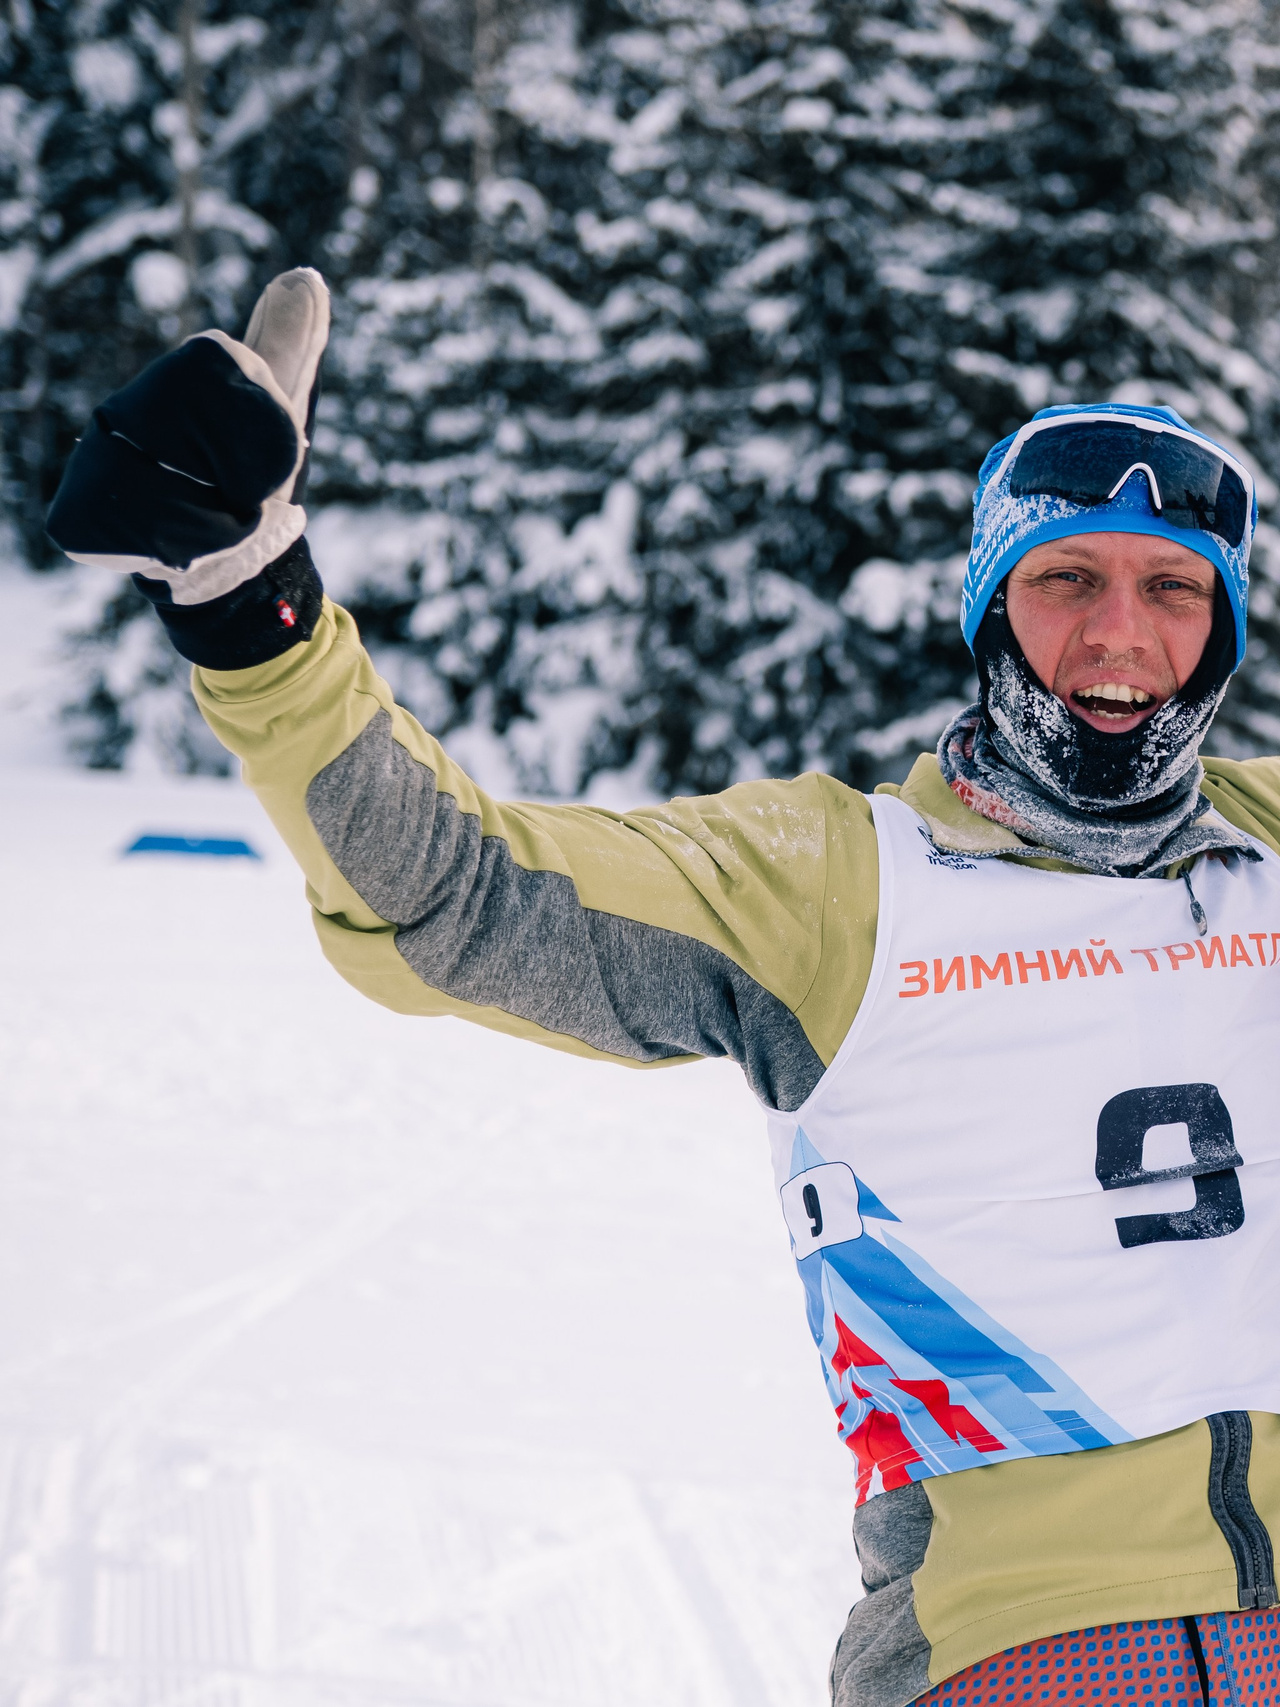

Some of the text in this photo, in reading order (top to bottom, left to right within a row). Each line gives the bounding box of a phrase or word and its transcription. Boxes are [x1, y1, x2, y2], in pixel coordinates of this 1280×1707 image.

[899, 938, 1123, 998] ЗИМНИЙ
[1095, 1082, 1246, 1249] 9
[802, 1183, 823, 1238] 9
